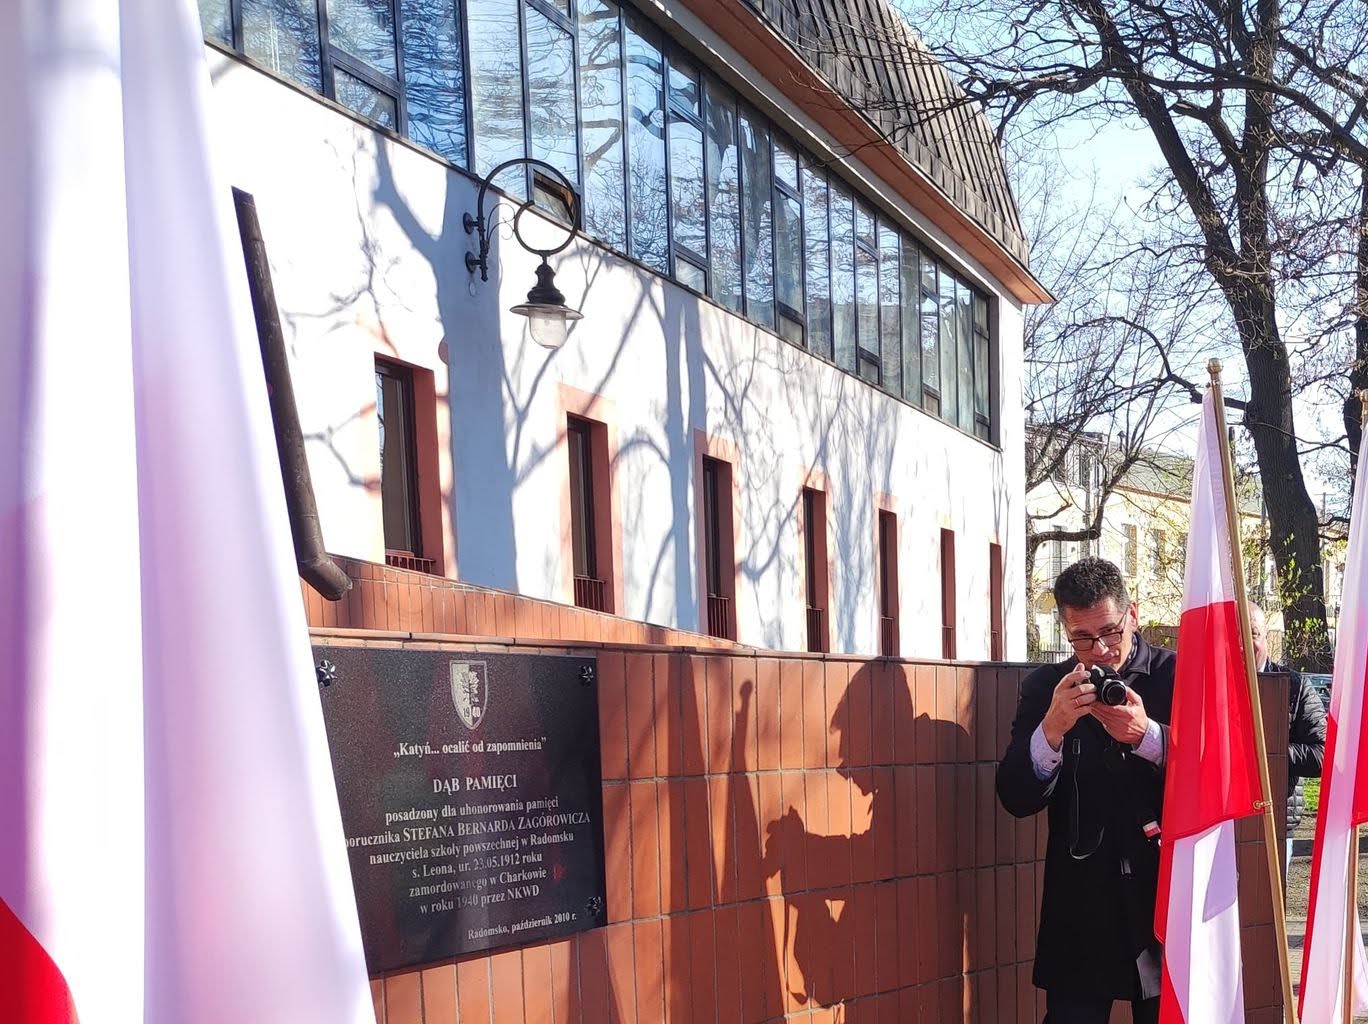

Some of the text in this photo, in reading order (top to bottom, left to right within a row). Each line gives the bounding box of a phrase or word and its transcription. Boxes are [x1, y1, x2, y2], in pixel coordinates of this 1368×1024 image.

[442, 740, 470, 754] ocalić
[472, 740, 484, 753] od
[486, 737, 547, 755] zapomnienia”
[433, 774, 517, 795] DĄB PAMIĘCI
[385, 796, 559, 825] posadzony dla uhonorowania pamięci
[369, 846, 429, 864] nauczyciela
[463, 836, 519, 856] powszechnej
[521, 838, 528, 846] w
[530, 830, 574, 846] Radomsku
[412, 852, 543, 878] s. Leona, ur. 23.05.1912 roku
[409, 867, 547, 897] zamordowanego w Charkowie
[420, 904, 428, 914] w
[431, 899, 454, 913] roku
[481, 890, 505, 908] przez
[507, 884, 540, 900] NKWD
[468, 911, 577, 940] Radomsko, październik 2010 r.
